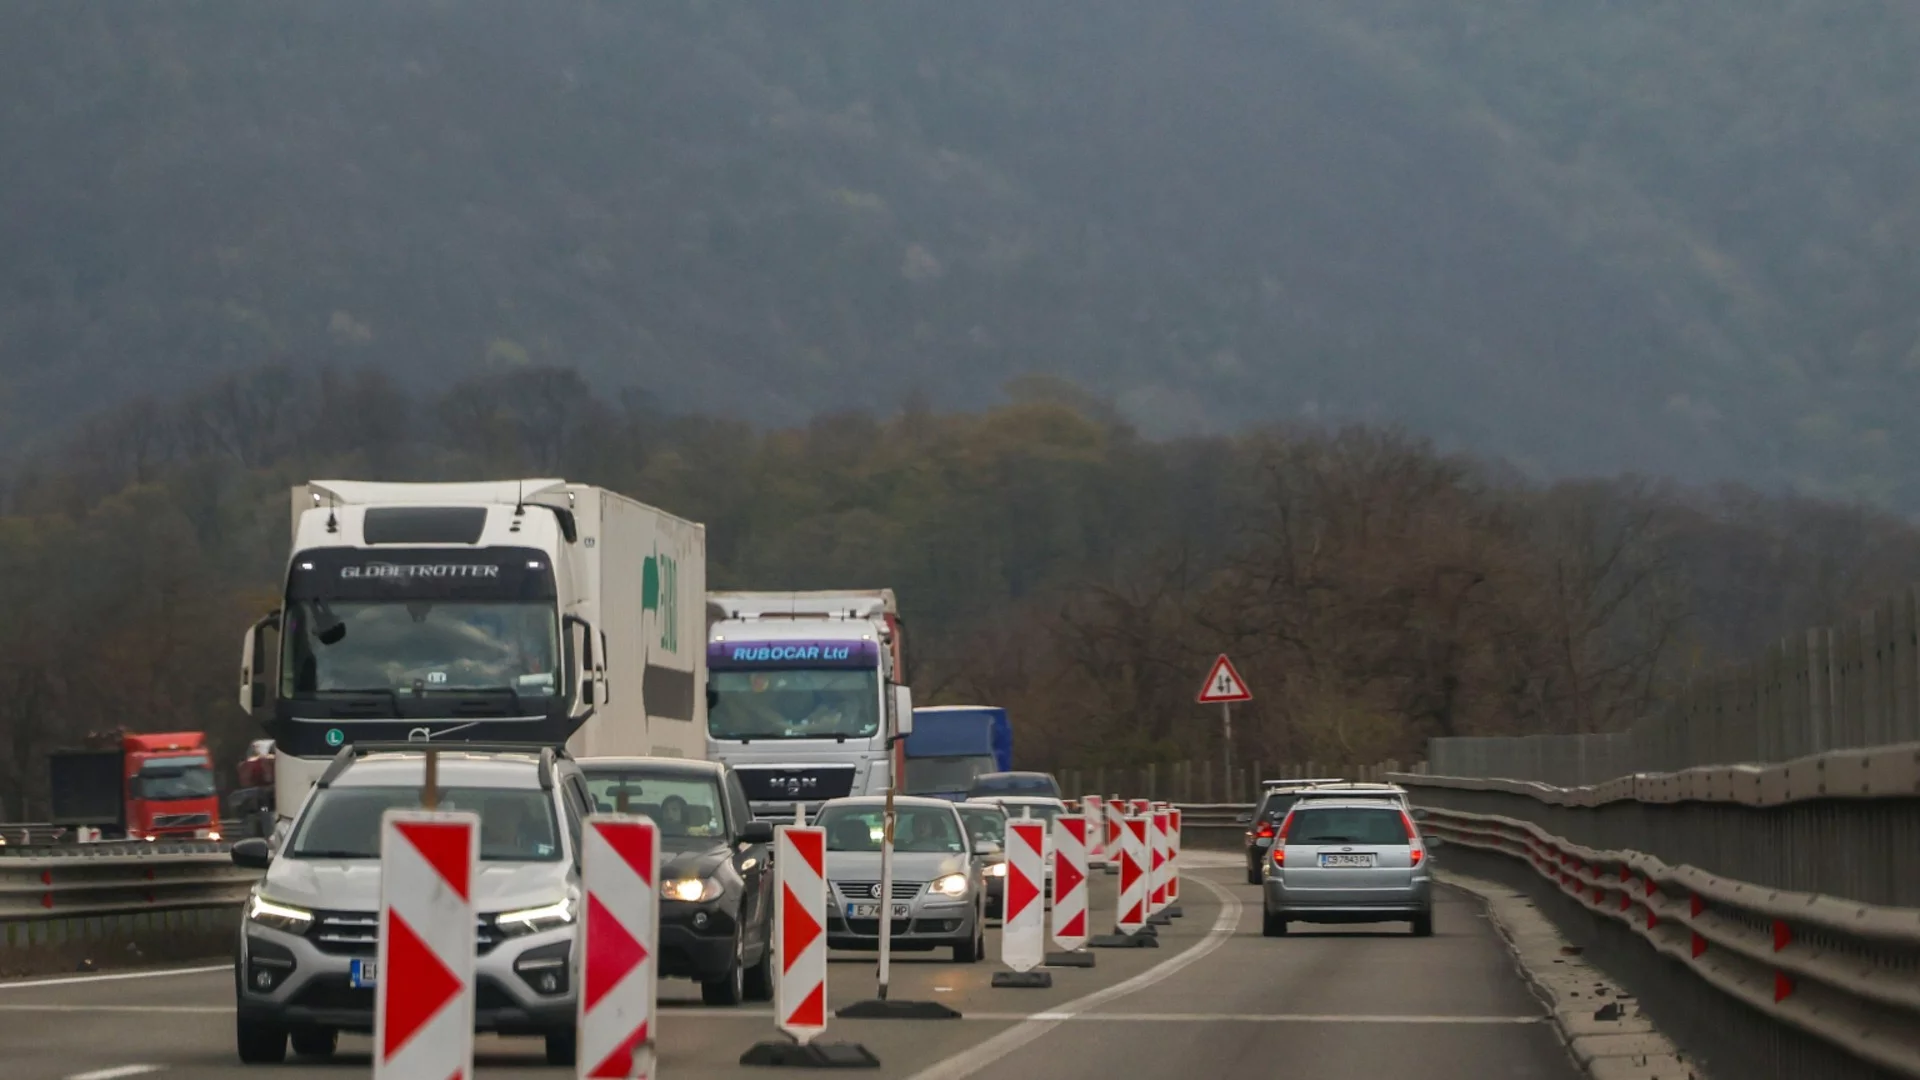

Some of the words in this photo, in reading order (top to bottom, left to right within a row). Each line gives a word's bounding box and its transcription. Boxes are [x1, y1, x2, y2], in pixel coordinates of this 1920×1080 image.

[341, 565, 499, 579] GLOBETROTTER
[733, 646, 819, 660] RUBOCAR
[823, 646, 849, 659] Ltd
